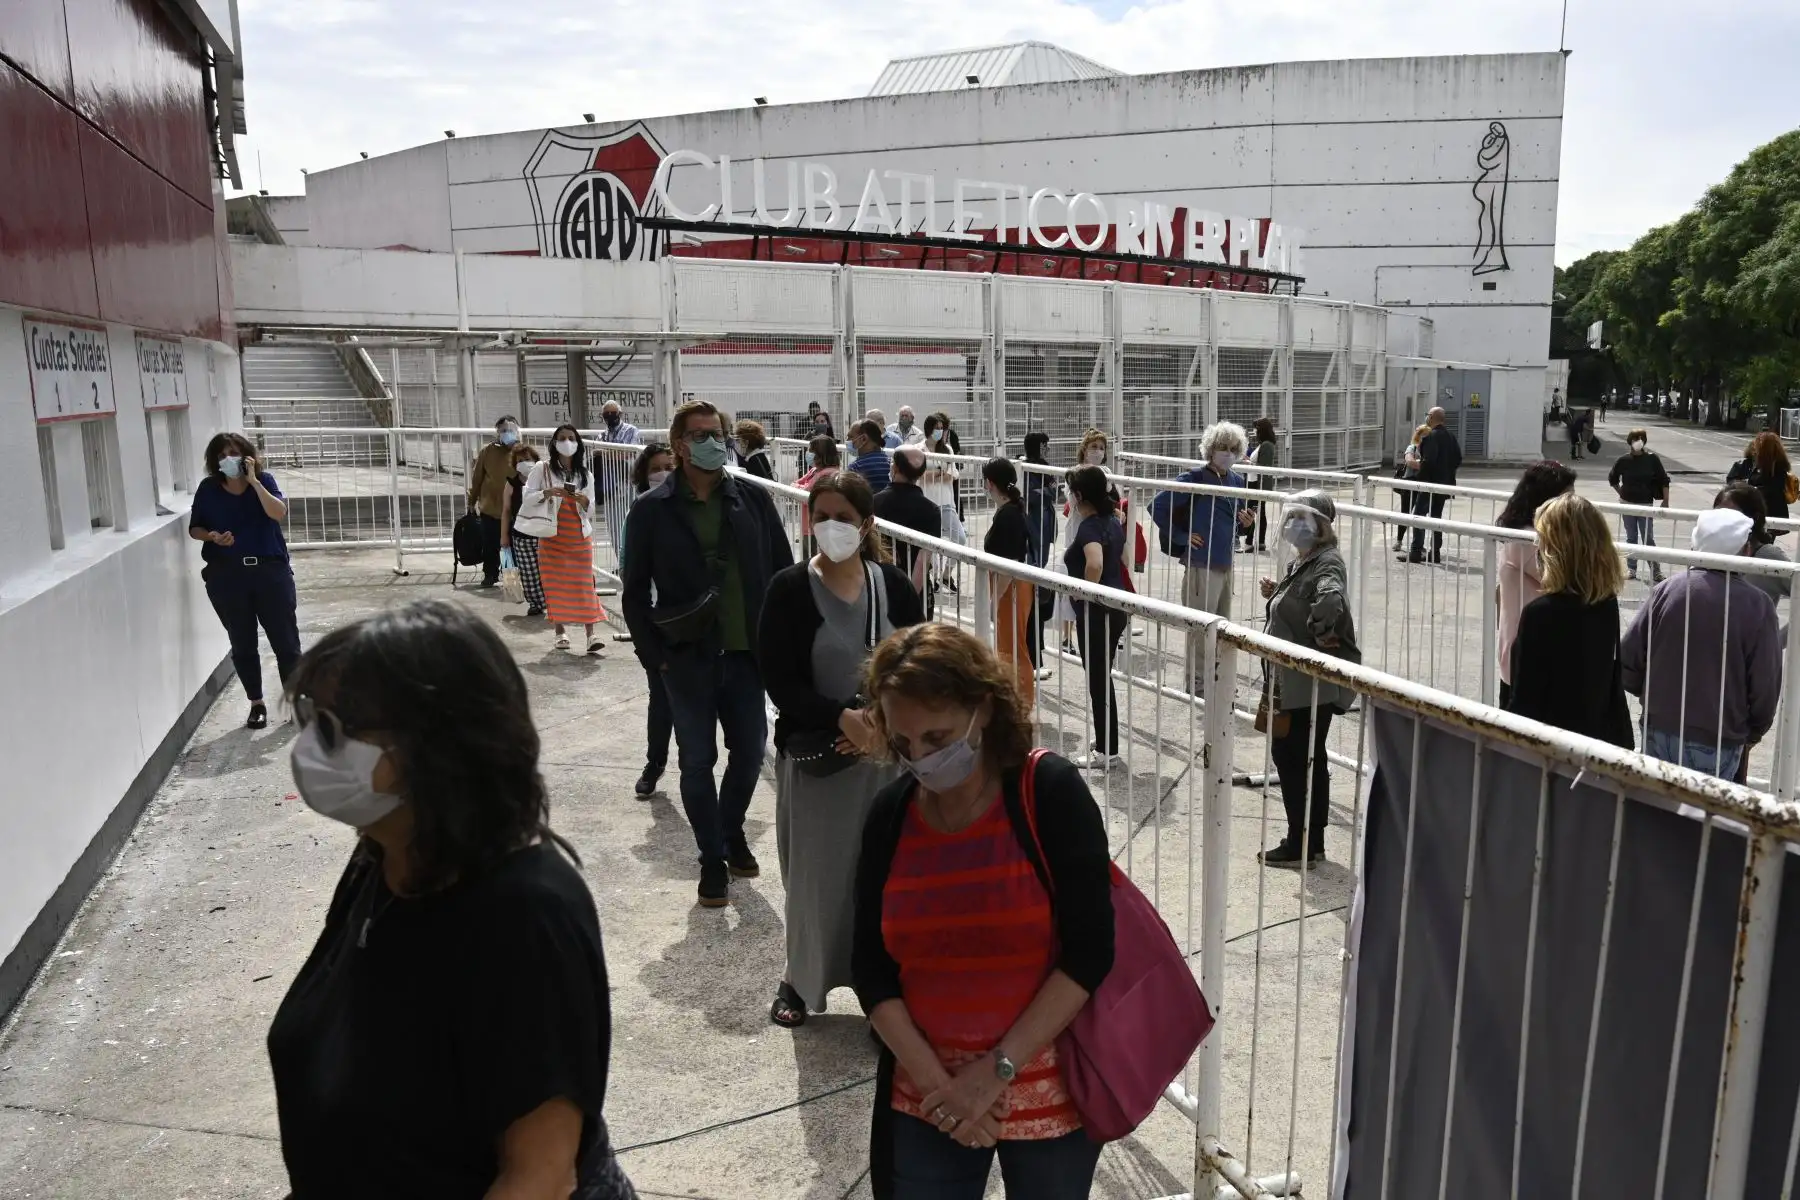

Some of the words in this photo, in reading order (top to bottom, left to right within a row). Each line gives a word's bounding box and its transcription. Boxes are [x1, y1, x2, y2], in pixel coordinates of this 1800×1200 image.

[656, 149, 839, 228] CLUB
[852, 168, 1109, 251] ATLETICO
[1115, 197, 1227, 264] RIVER
[31, 326, 70, 371] Cuotas
[69, 330, 107, 373] Sociales
[91, 381, 100, 410] 2
[530, 390, 560, 406] CLUB
[619, 391, 655, 408] RIVER
